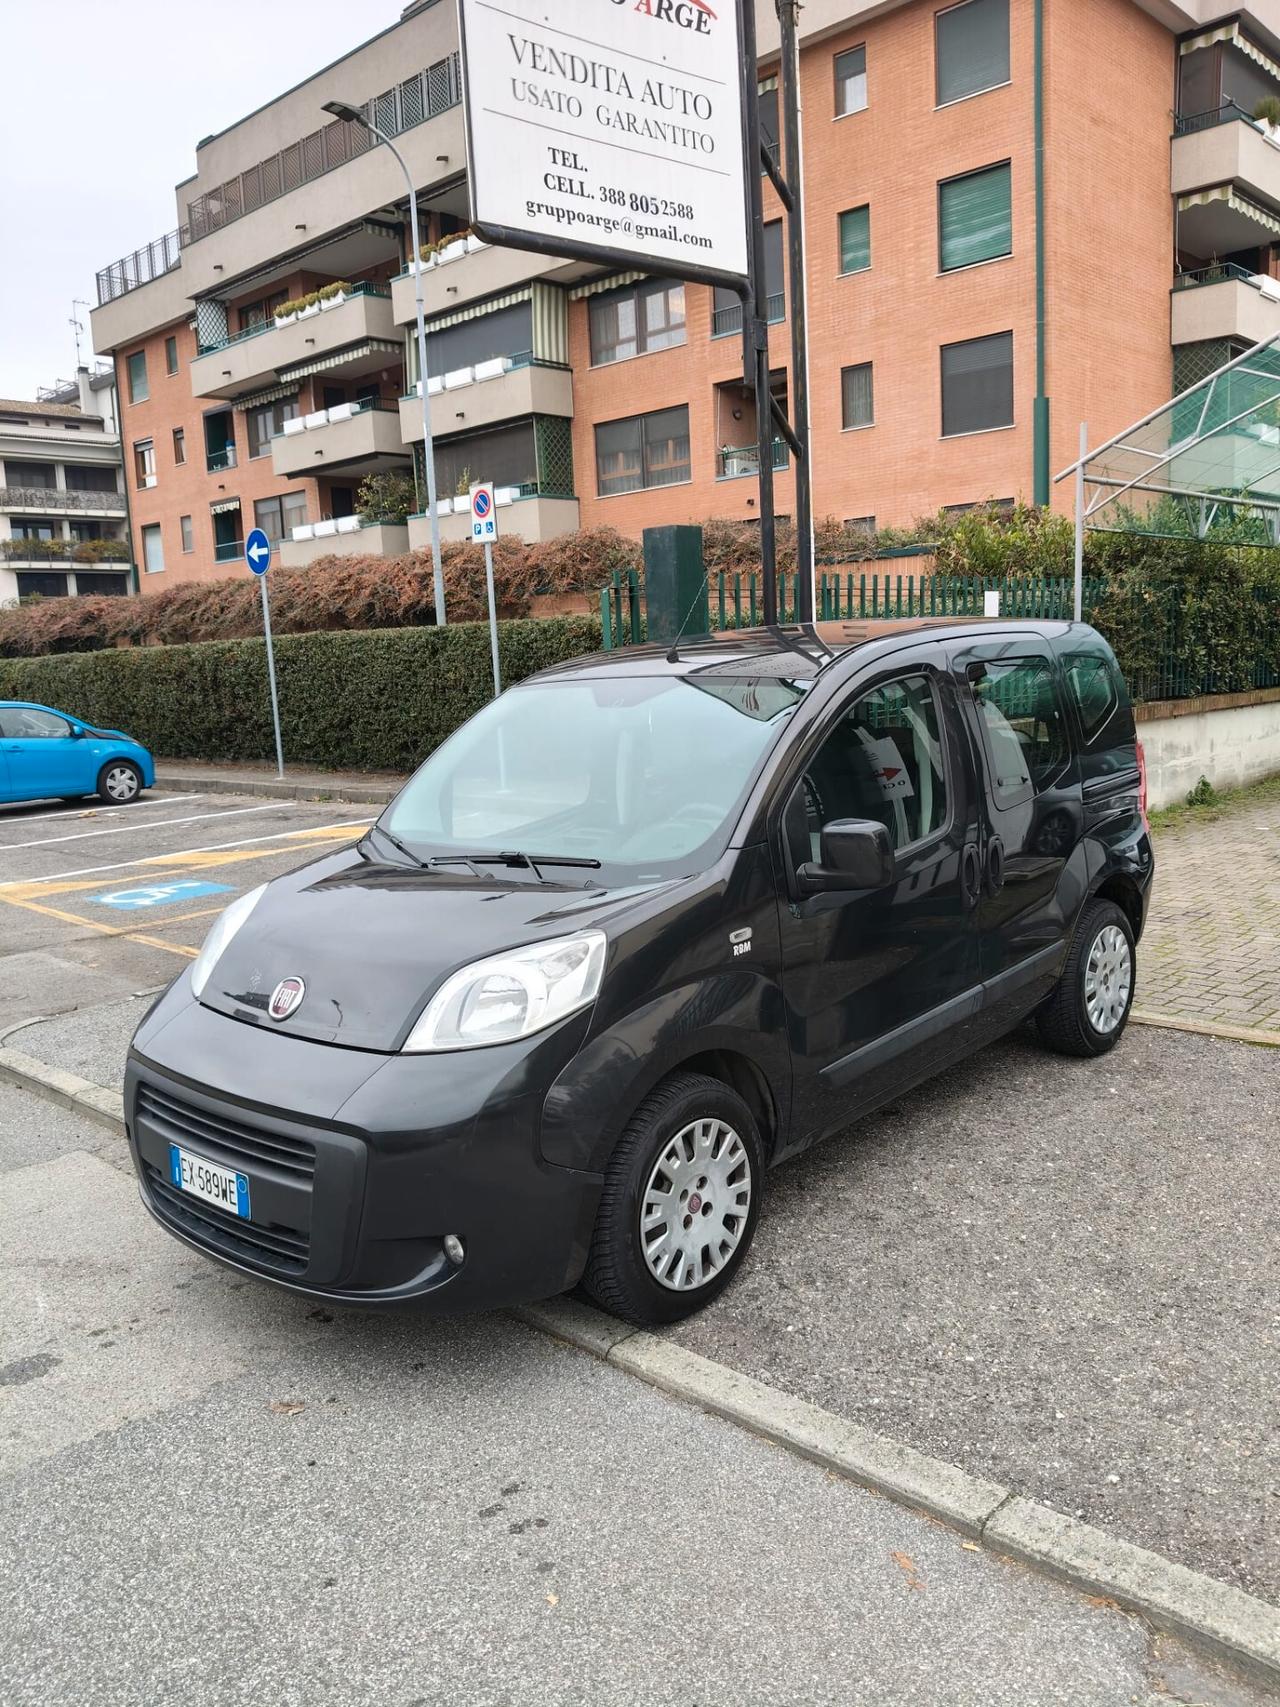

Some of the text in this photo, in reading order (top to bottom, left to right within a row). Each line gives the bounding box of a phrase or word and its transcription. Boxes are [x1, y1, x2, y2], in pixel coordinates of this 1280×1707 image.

[507, 33, 712, 120] VENDITA AUTO
[511, 78, 714, 154] USATO GARANTITO
[547, 146, 588, 172] TEL.
[543, 172, 594, 200] CELL.
[526, 200, 713, 249] gruppoarge@gmail.com
